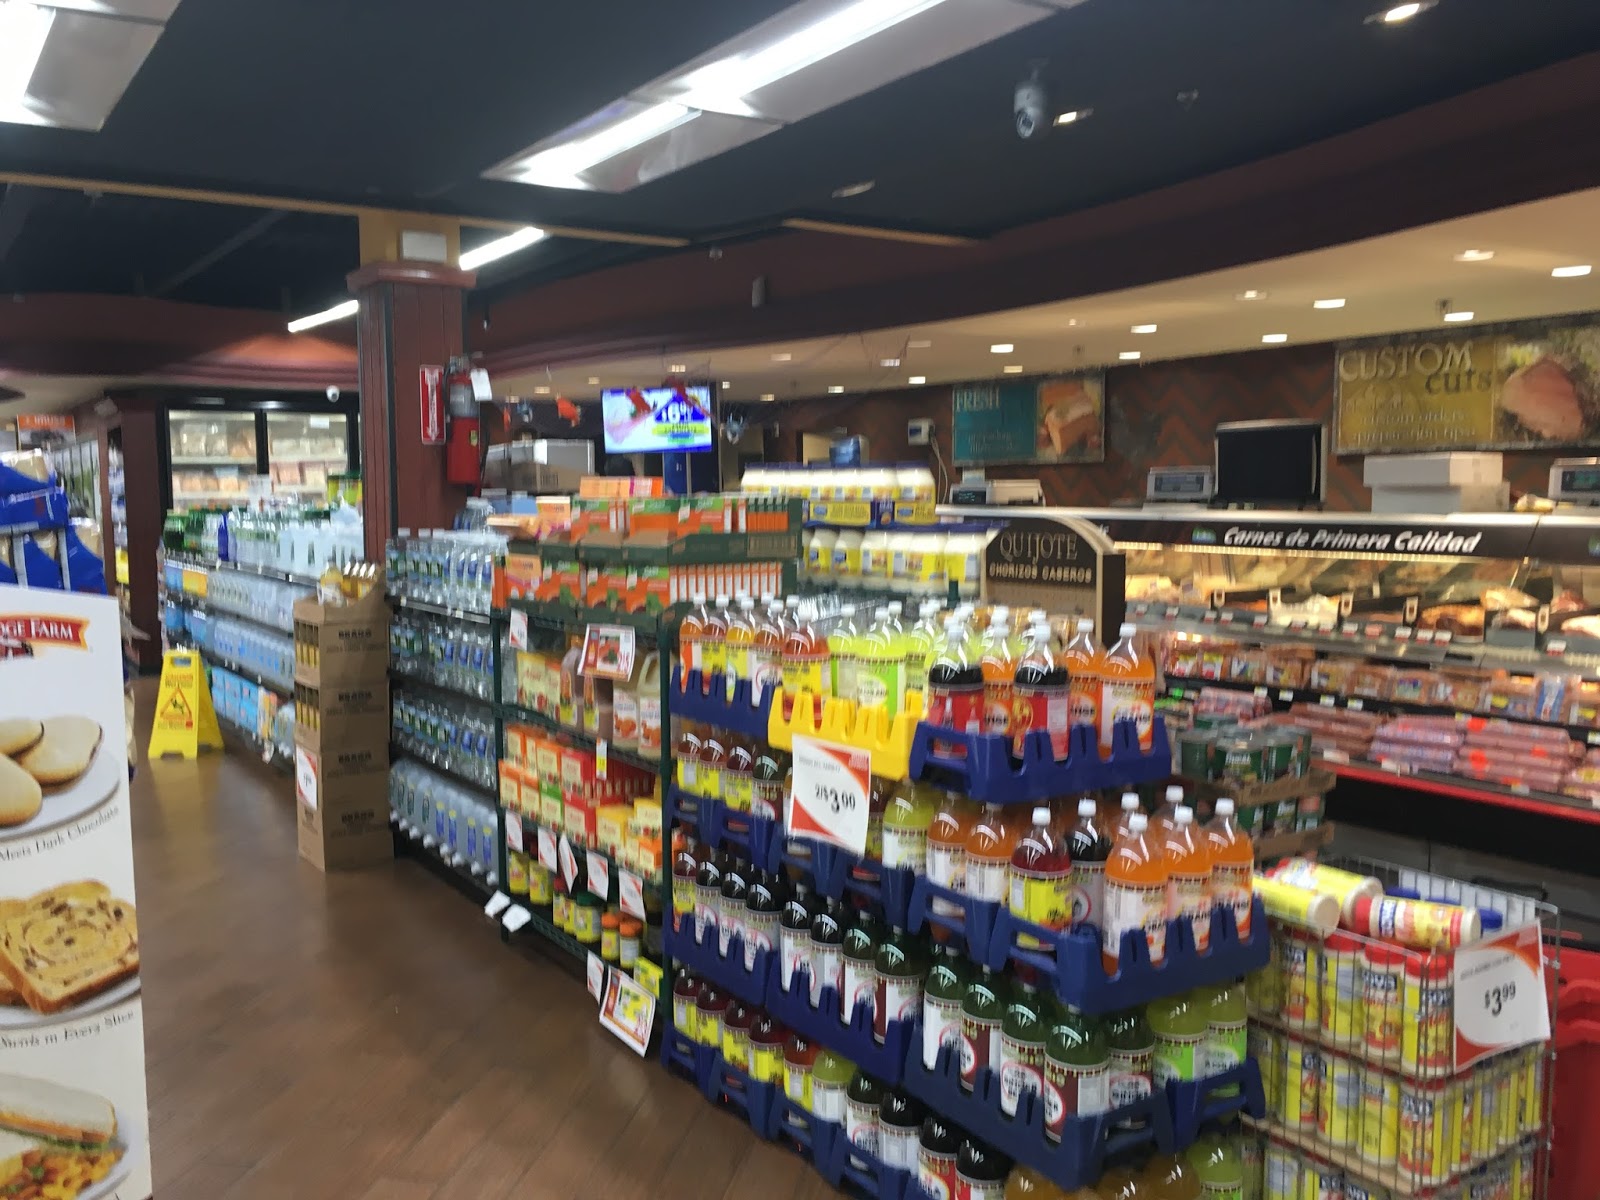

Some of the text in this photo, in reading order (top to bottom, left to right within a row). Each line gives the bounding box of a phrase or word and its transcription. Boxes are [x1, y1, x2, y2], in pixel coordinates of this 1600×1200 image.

[1339, 341, 1473, 382] CUSTOM
[1424, 369, 1492, 395] cuts
[1000, 531, 1078, 563] QUIJOTE
[1224, 526, 1483, 553] Carnes de Primera Calidad
[989, 562, 1092, 583] CHORIZOS CASEROS
[30, 618, 73, 641] FARM
